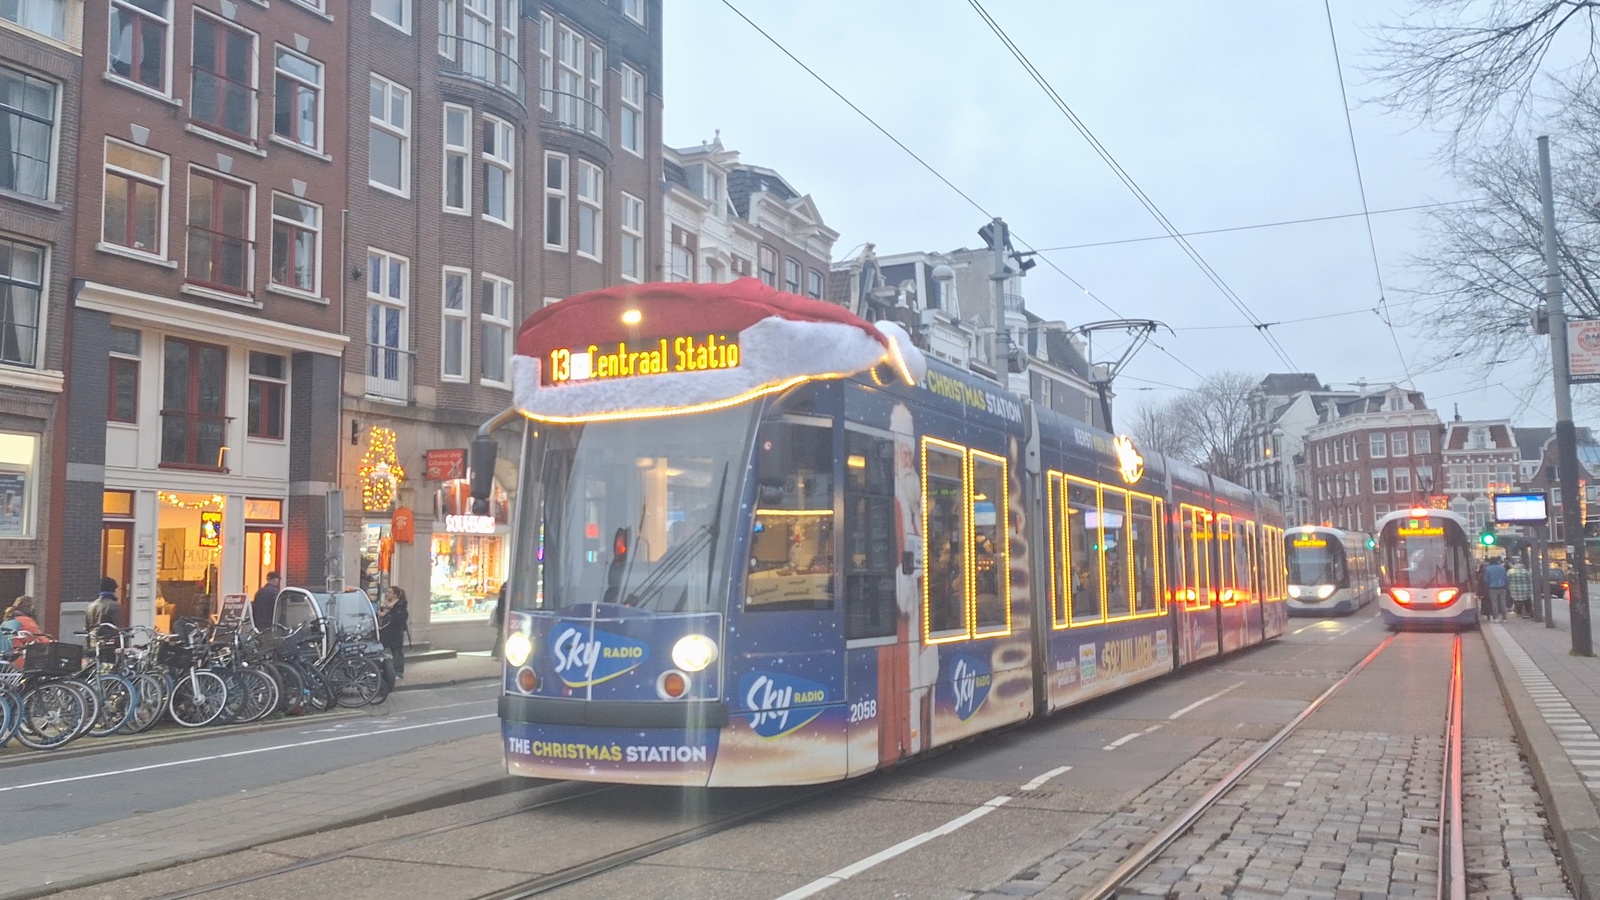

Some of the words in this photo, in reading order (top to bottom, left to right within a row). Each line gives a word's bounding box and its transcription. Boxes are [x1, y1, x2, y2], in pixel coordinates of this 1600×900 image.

[550, 348, 570, 381] 13
[587, 338, 669, 379] Centraal
[927, 369, 986, 411] CHRISTMAS
[985, 392, 1022, 423] STATION
[554, 627, 601, 678] Sky
[603, 646, 643, 658] RADIO
[747, 675, 793, 730] Sky
[794, 690, 825, 703] RADIO
[953, 658, 976, 712] Sky
[850, 699, 877, 723] 2058
[508, 737, 531, 755] THE
[532, 740, 623, 762] CHRISTMAS
[626, 745, 707, 763] STATION
